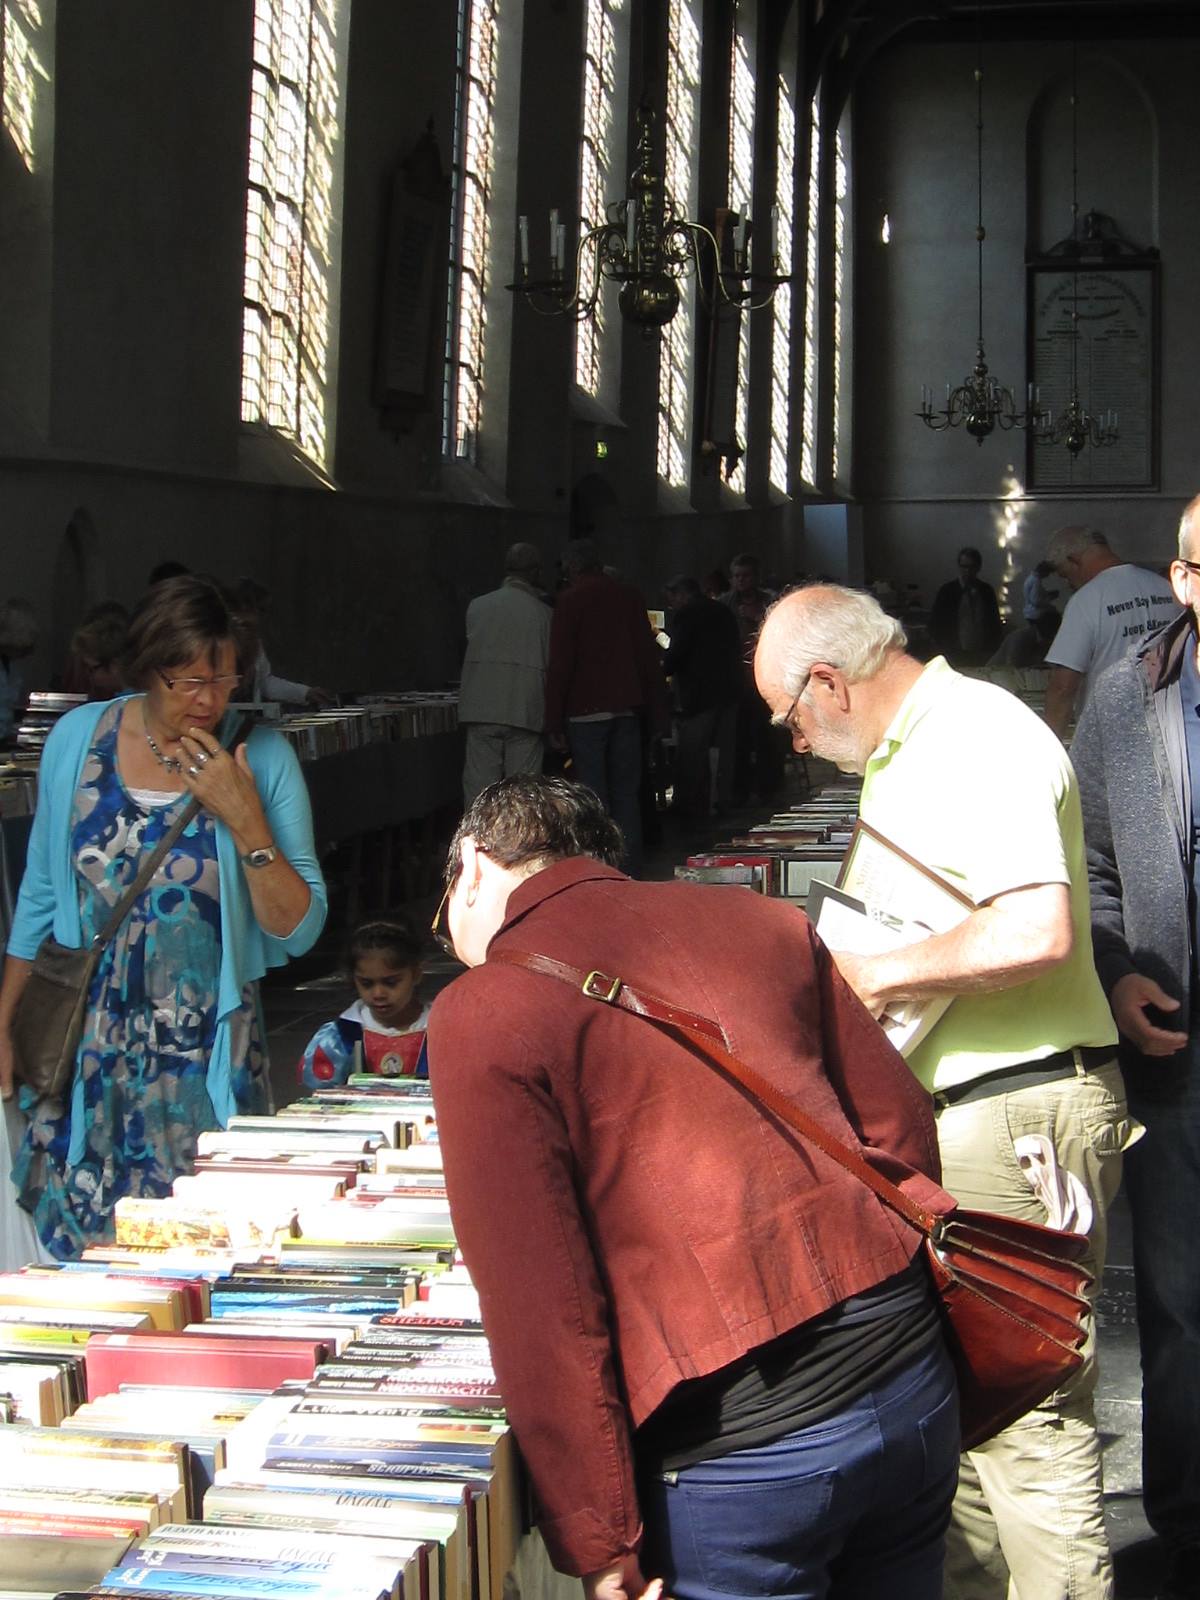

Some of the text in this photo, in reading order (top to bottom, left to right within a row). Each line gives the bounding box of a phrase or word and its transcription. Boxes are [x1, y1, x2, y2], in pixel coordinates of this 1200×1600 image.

[1106, 600, 1135, 616] Never
[1134, 597, 1150, 609] Say
[1122, 623, 1146, 637] Jeep
[379, 1316, 464, 1327] SHELDON
[377, 1382, 491, 1396] MIDDERNACHT
[161, 1525, 206, 1536] JUDITH
